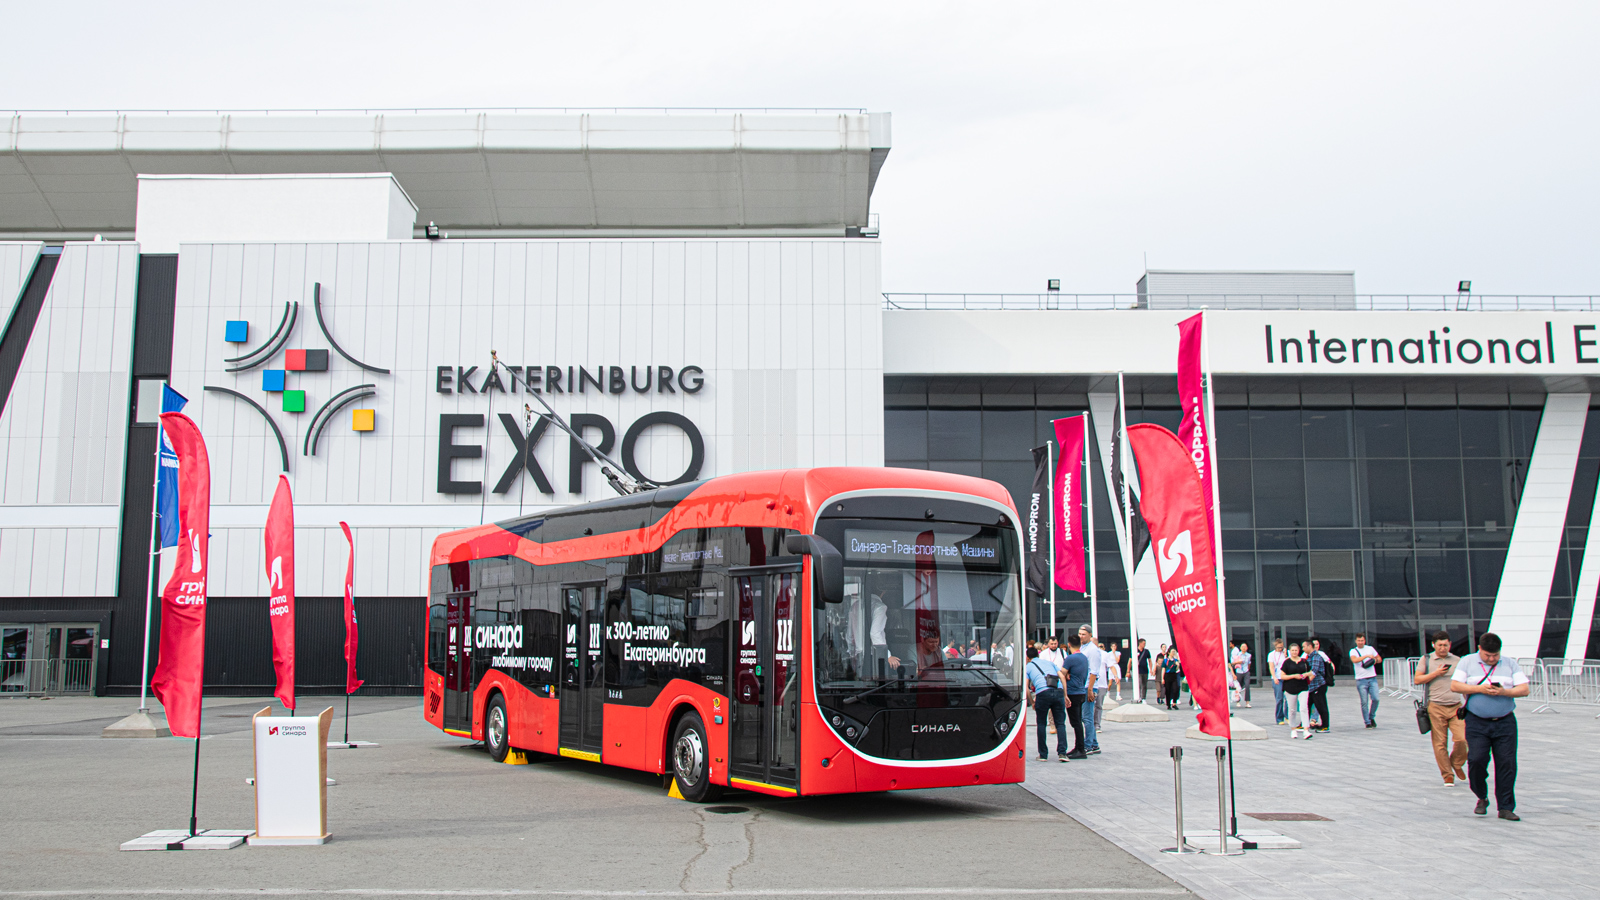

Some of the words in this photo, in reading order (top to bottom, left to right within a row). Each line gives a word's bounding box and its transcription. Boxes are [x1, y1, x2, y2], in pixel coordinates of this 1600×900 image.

[1265, 321, 1555, 364] International
[436, 365, 705, 394] EKATERINBURG
[436, 410, 705, 494] EXPO
[1063, 472, 1072, 541] INNOPROM
[1029, 492, 1040, 552] INNOPROM
[851, 538, 958, 557] Синара-Транспортные
[961, 543, 995, 558] Машины
[475, 625, 523, 655] синара
[606, 625, 613, 640] к
[613, 621, 670, 641] 300-летию
[492, 652, 527, 671] любимому
[527, 656, 553, 673] городу
[624, 641, 706, 667] Екатеринбурга
[911, 723, 961, 733] СИНАРА
